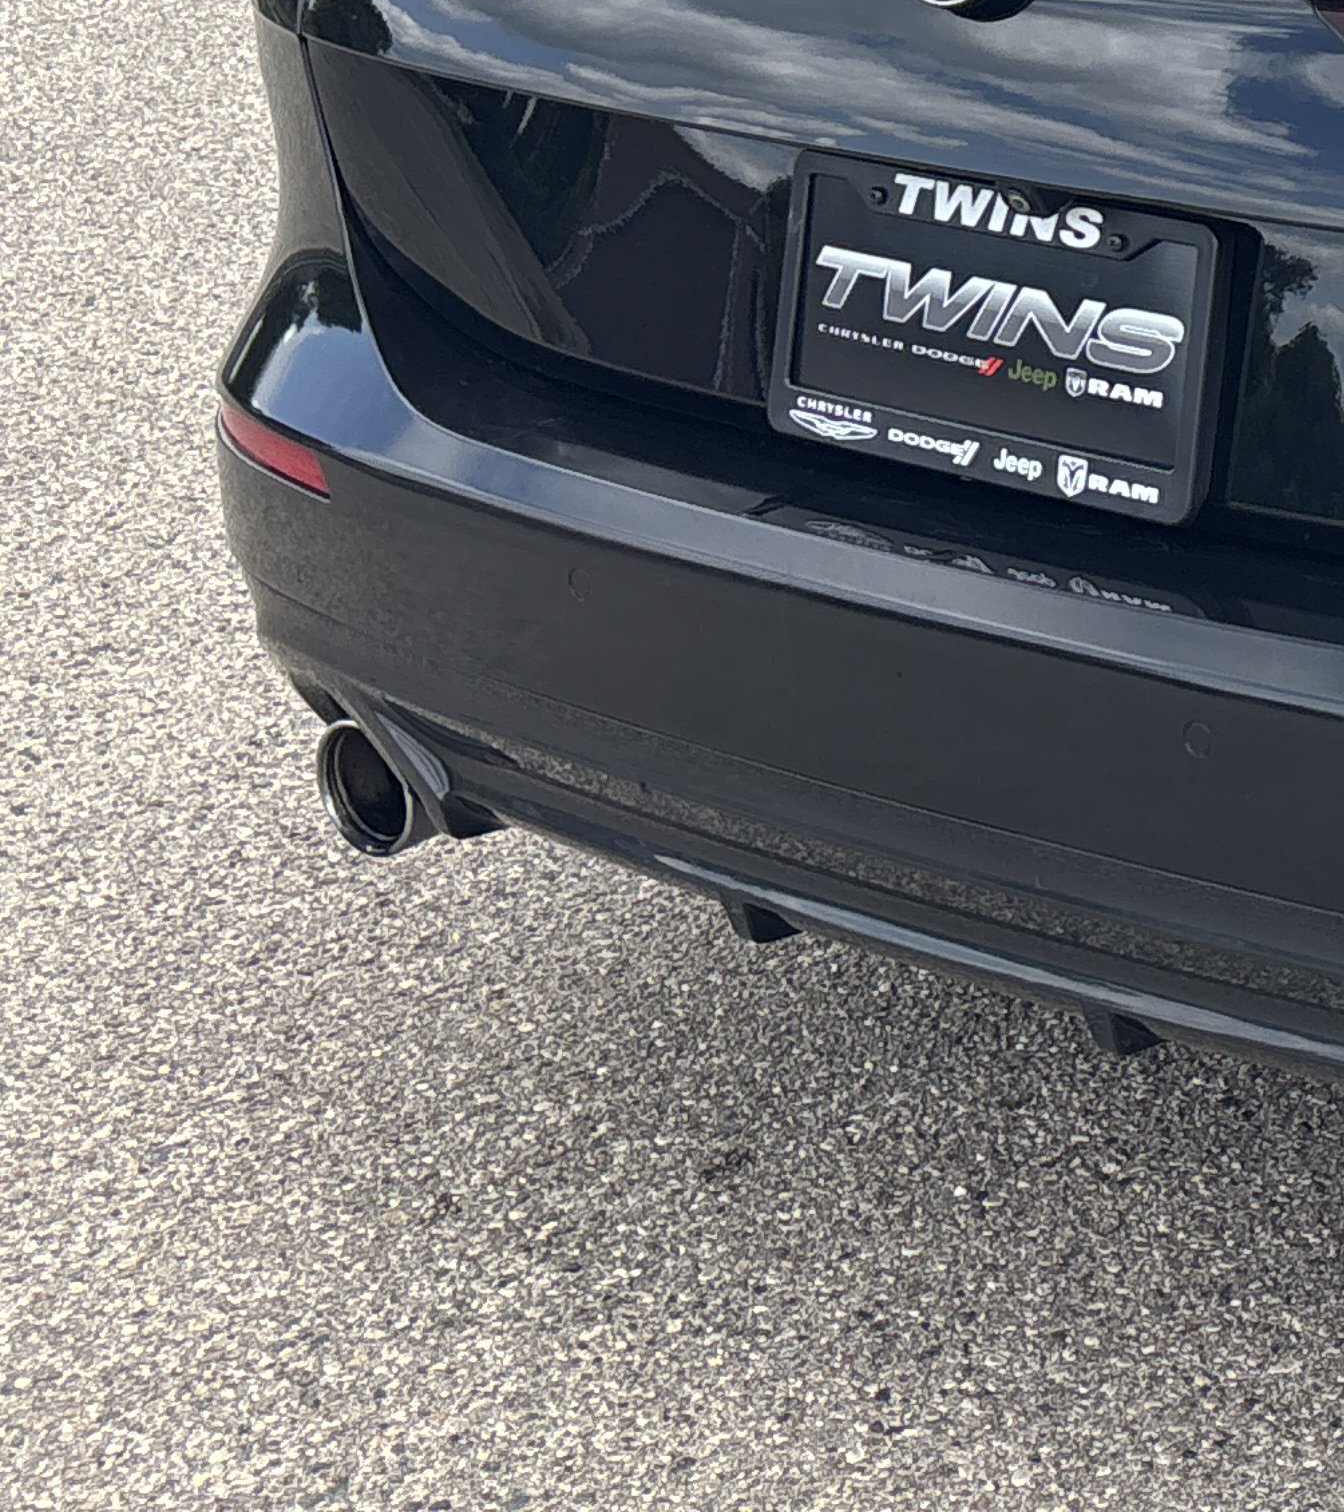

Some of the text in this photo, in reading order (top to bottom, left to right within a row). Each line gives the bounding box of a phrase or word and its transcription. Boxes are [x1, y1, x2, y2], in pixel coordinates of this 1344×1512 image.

[894, 173, 1104, 249] TWINS
[816, 245, 1185, 374] TWINS
[817, 323, 1163, 409] CHRYSLER DODGE Jeep RAM
[797, 396, 1160, 505] CHRYSLER DODGE Jeep RAM
